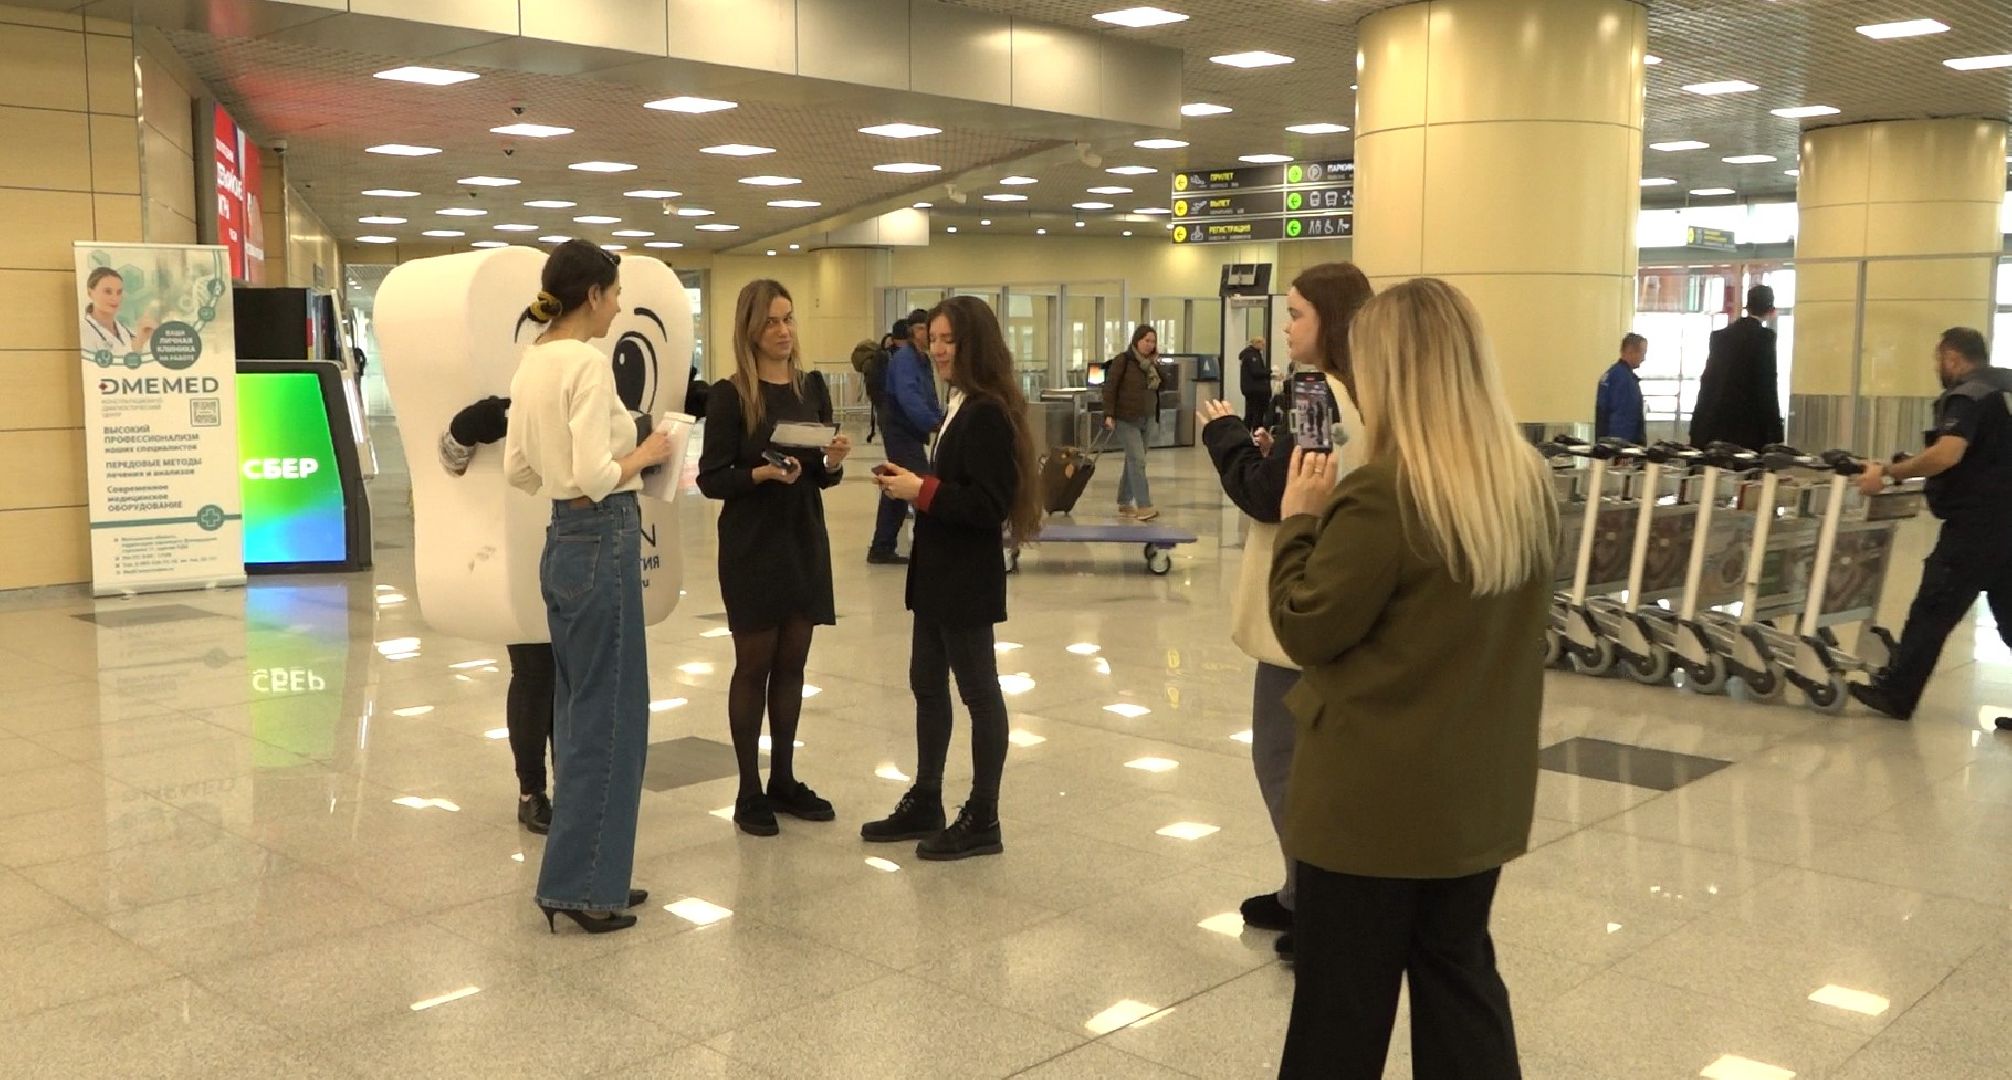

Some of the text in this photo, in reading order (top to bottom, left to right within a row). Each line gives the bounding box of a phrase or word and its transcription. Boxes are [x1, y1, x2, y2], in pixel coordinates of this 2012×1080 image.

[100, 377, 219, 395] DMEMED
[103, 424, 150, 434] ВЫСОКИЙ
[104, 434, 199, 444] ПРОФЕССИОНАЛИЗМ
[106, 457, 202, 469] ПЕРЕДОВЫЕ МЕТОДЫ
[243, 457, 318, 479] СБЕР
[107, 501, 182, 512] ОБОРУДОВАНИЕ
